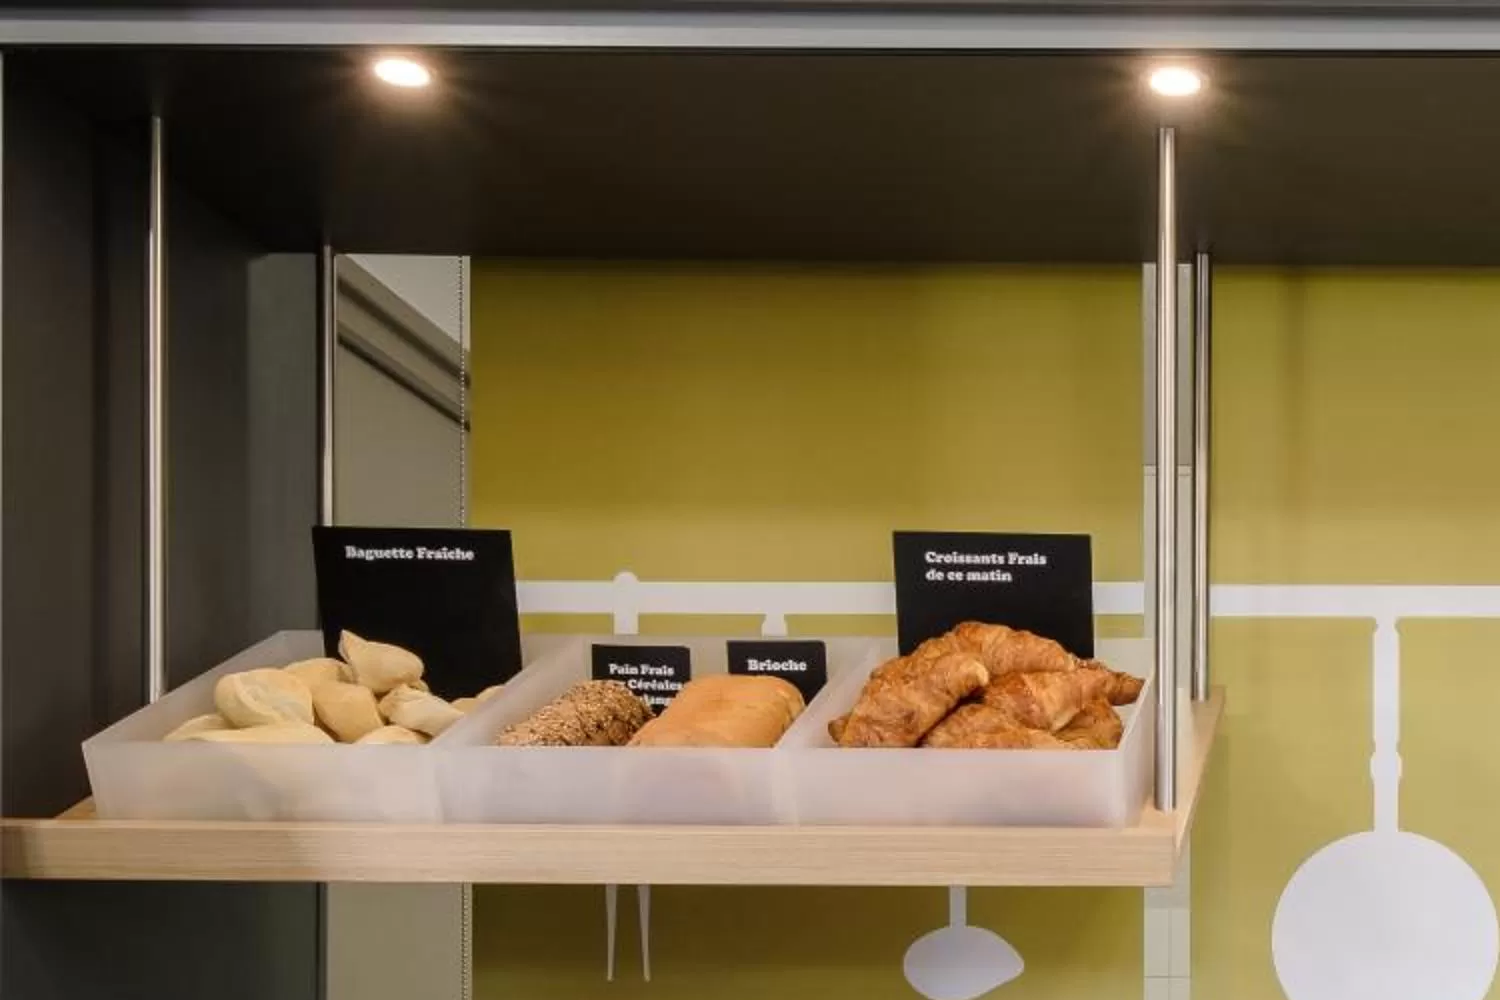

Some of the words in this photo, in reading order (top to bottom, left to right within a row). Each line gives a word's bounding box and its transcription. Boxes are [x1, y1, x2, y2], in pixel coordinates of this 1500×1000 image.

[344, 545, 414, 561] Baguette
[924, 551, 1005, 565] Croissants
[1007, 552, 1047, 565] Frais
[925, 570, 944, 581] de
[946, 571, 963, 581] ce
[965, 570, 1012, 582] matin
[609, 664, 638, 674] Pain
[640, 664, 675, 675] Frais
[747, 659, 807, 671] Brioche
[627, 679, 682, 691] Céréales
